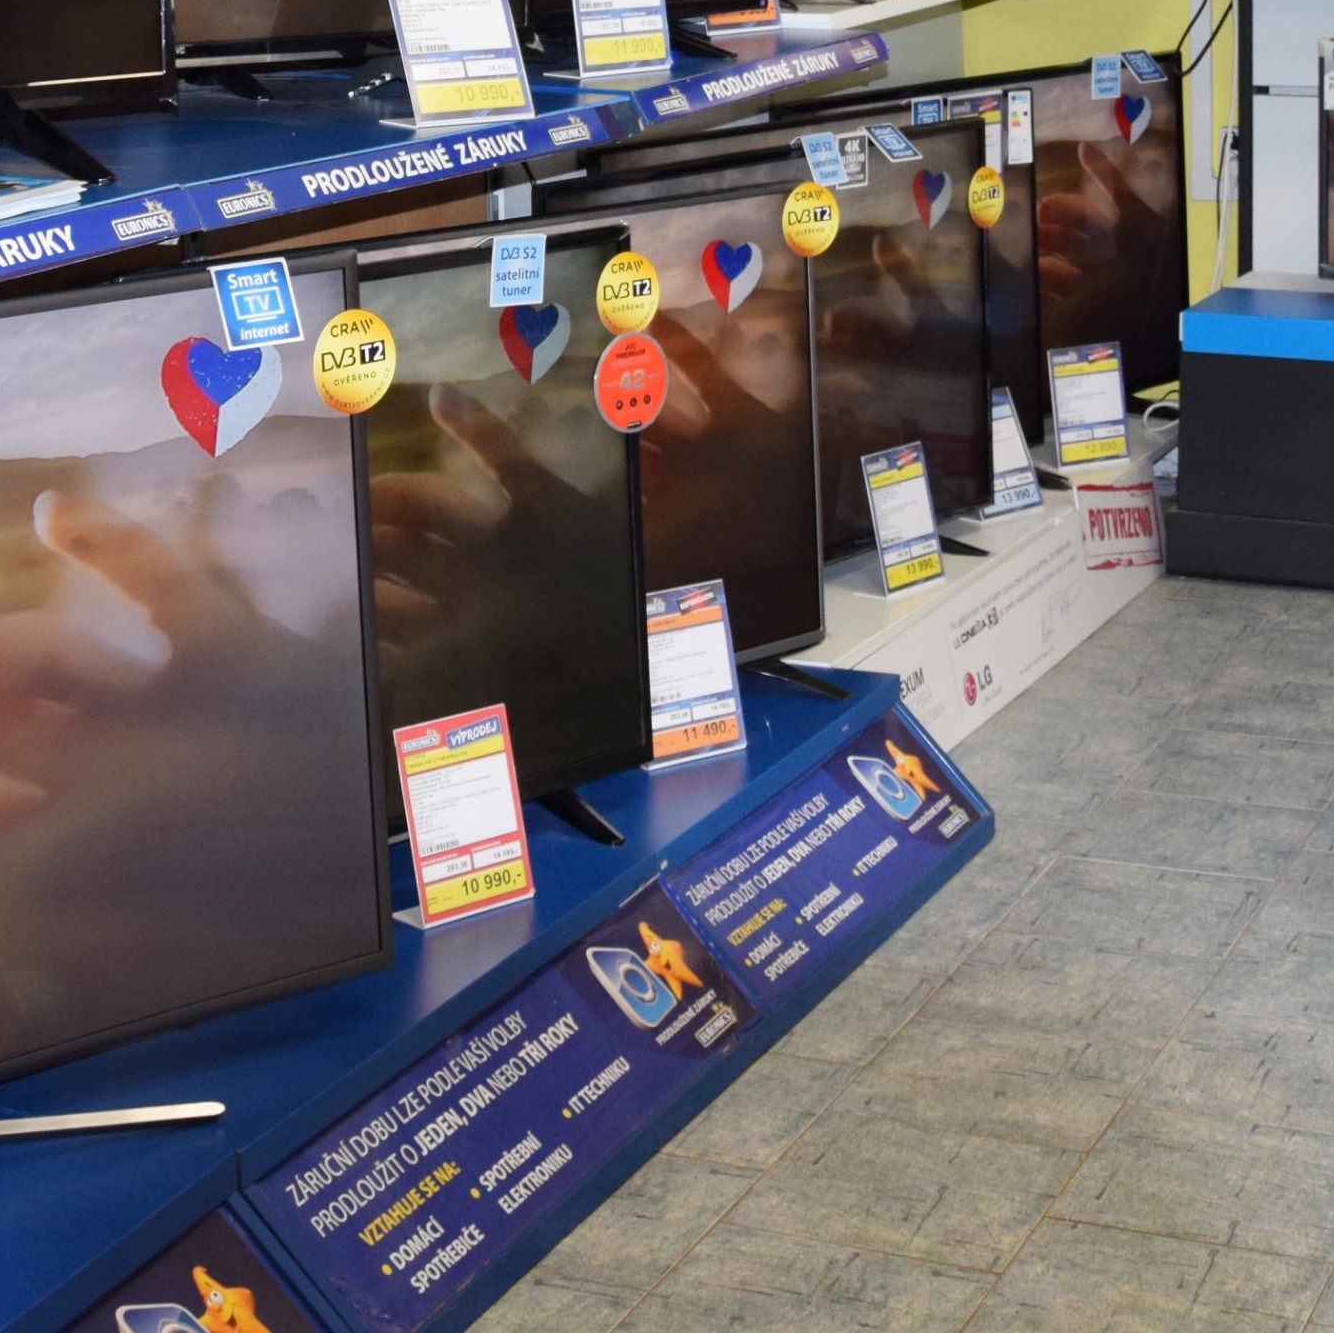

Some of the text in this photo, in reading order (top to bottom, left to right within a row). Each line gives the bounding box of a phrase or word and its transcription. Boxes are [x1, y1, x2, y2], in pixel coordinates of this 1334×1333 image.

[702, 51, 839, 101] PRODLOUŽENÉ ZÁRUKY
[918, 104, 939, 113] Smart
[845, 140, 860, 153] 4K
[223, 131, 527, 216] EURONICS PRODLOUŽENÉ ZÁRUKY
[116, 212, 168, 238] EURONICS
[814, 207, 830, 221] T2
[522, 246, 537, 260] S2
[227, 268, 278, 290] Smart
[495, 268, 540, 283] satelitní
[244, 294, 269, 313] TV
[501, 283, 532, 298] tuner
[240, 323, 290, 341] internet
[361, 342, 385, 364] T2
[619, 369, 645, 391] 42
[1088, 505, 1154, 542] POTVRZENO
[918, 557, 939, 573] 990,-
[978, 665, 993, 693] LG
[450, 721, 497, 747] VÝPRODEJ
[683, 720, 735, 741] 11 490,-
[462, 869, 521, 896] 10 990,-
[685, 850, 749, 906] ZÁRUČNÍ DOBU
[704, 881, 760, 927] PRODLOUŽIT
[800, 882, 842, 922] SPOTŘEBNÍ
[815, 893, 864, 936] ELEKTRONIKU
[699, 1011, 733, 1047] EURONICS
[578, 1056, 633, 1108] TECHNIKU
[285, 1010, 529, 1208] ZÁRUČNÍ DOBU LZE PODLE VOLBY
[310, 1012, 580, 1239] PRODLOUŽIT JEDEN, NEBO ROKY
[479, 1130, 543, 1194] SPOTŘEBNÍ
[497, 1142, 574, 1216] ELEKTRONIKU
[358, 1191, 426, 1248] VZTAHUJE
[389, 1218, 445, 1272] DOMÁCÍ
[409, 1223, 485, 1294] SPOTŘEBIČE
